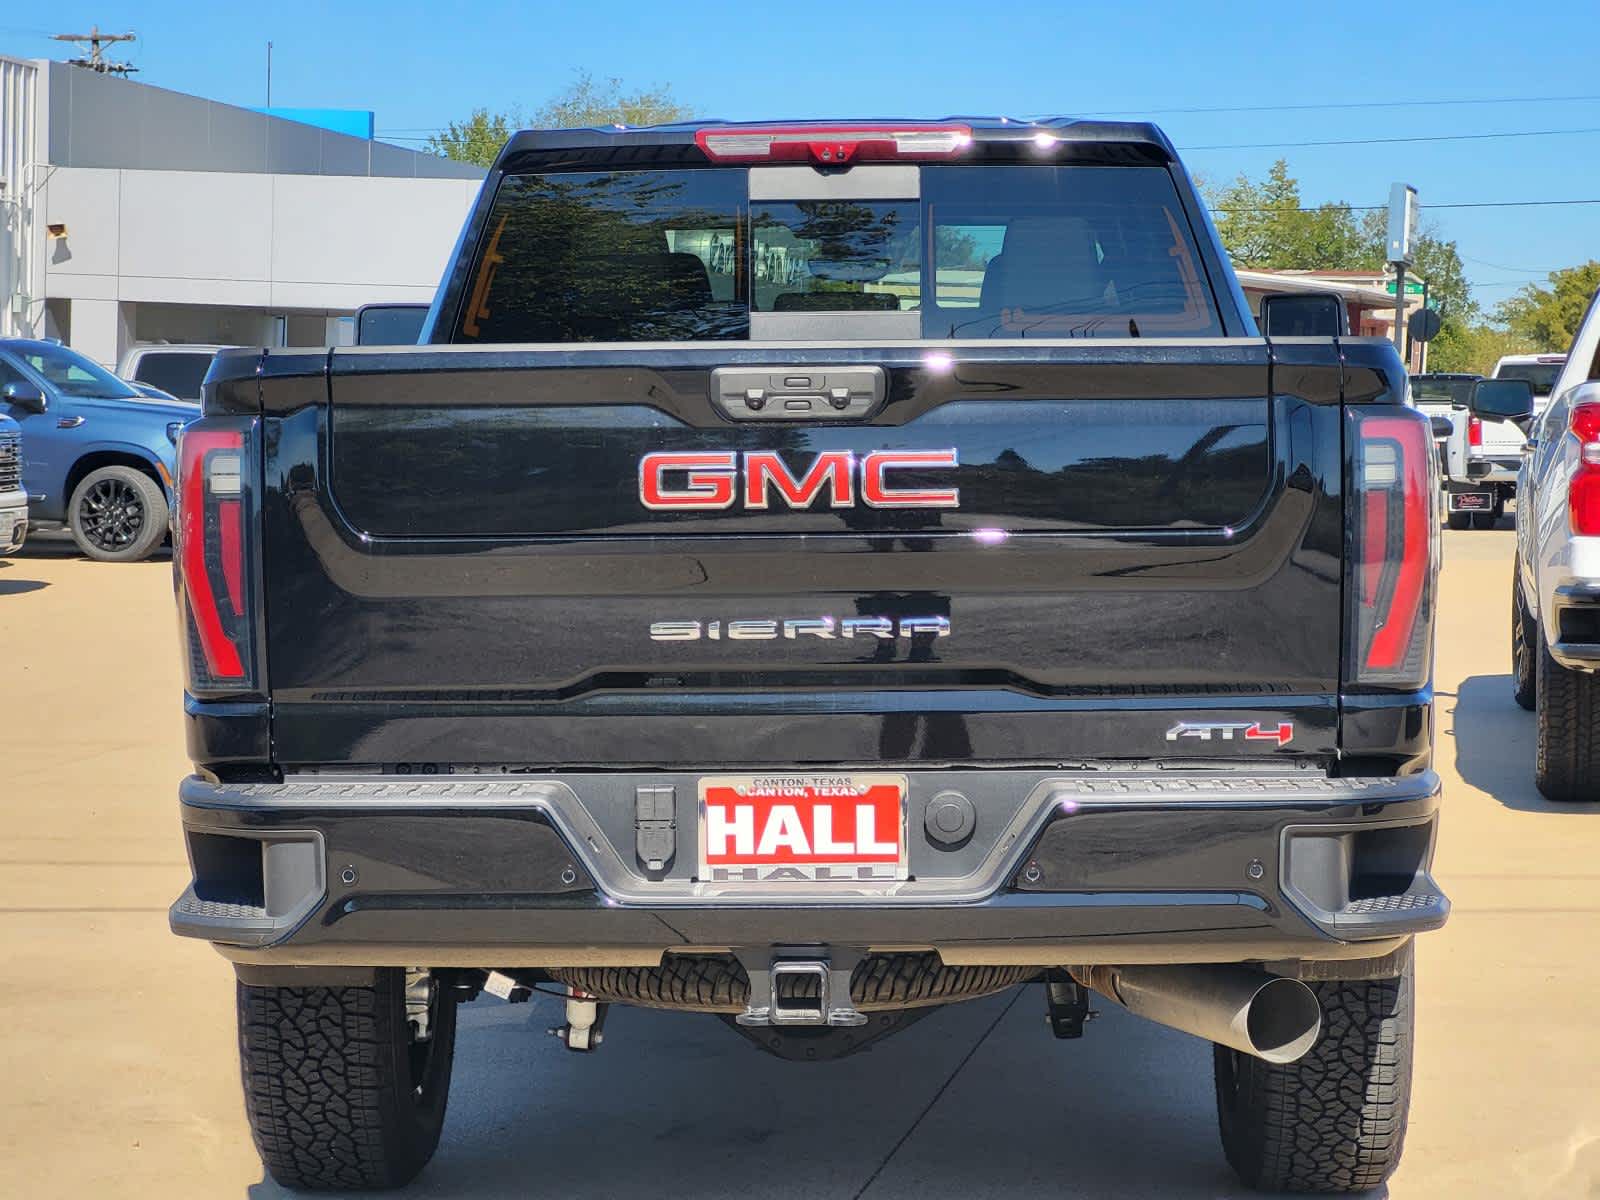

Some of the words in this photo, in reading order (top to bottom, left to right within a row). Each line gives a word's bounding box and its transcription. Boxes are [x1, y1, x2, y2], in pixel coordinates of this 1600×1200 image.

[639, 448, 960, 510] GMC
[650, 617, 951, 641] SIERRA
[1166, 722, 1294, 747] AT4
[811, 777, 852, 786] TEXAS
[813, 786, 858, 797] TEXAS
[707, 804, 898, 855] HALL
[713, 866, 895, 881] HALL
